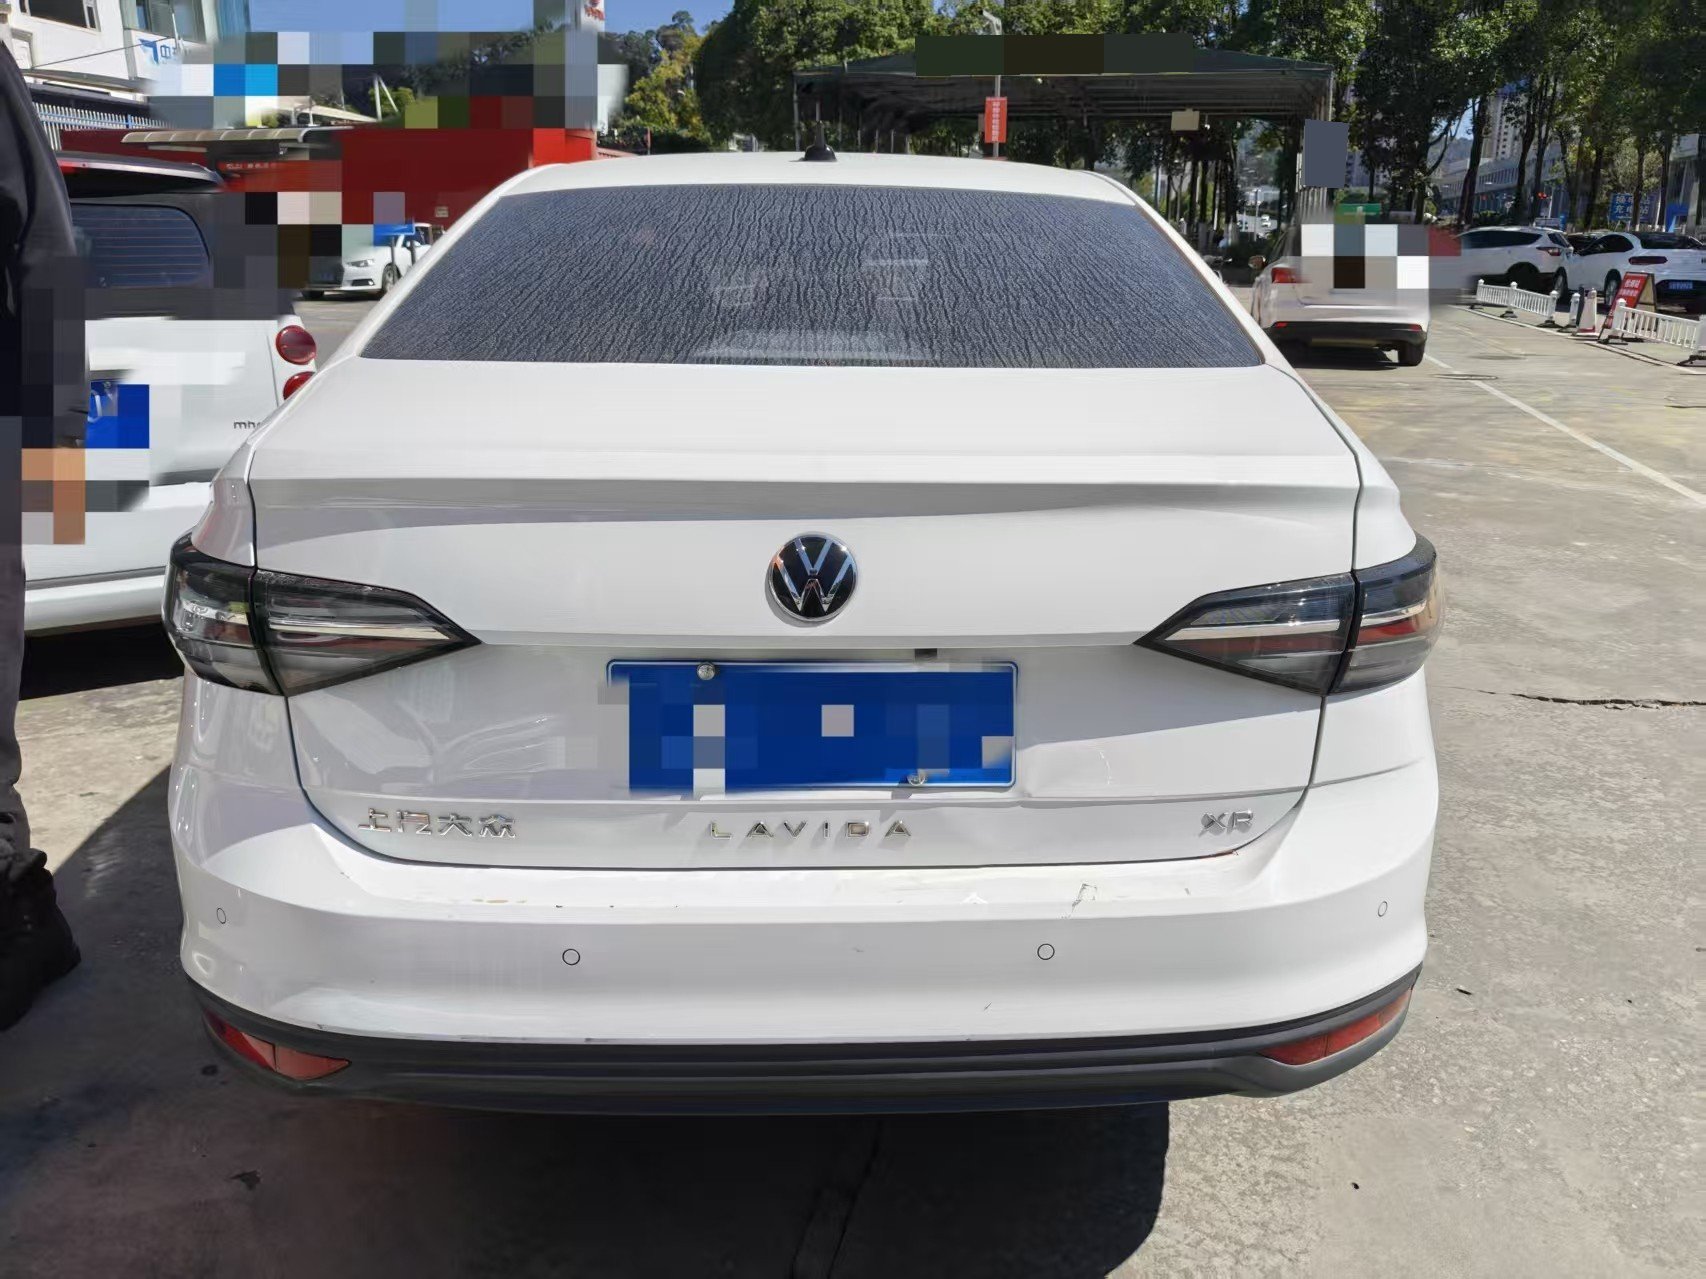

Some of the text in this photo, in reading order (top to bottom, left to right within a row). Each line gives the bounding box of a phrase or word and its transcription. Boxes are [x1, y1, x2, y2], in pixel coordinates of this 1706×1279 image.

[358, 808, 516, 839] 上汽大众
[710, 820, 911, 838] LAVIDA
[1202, 811, 1253, 831] XR
